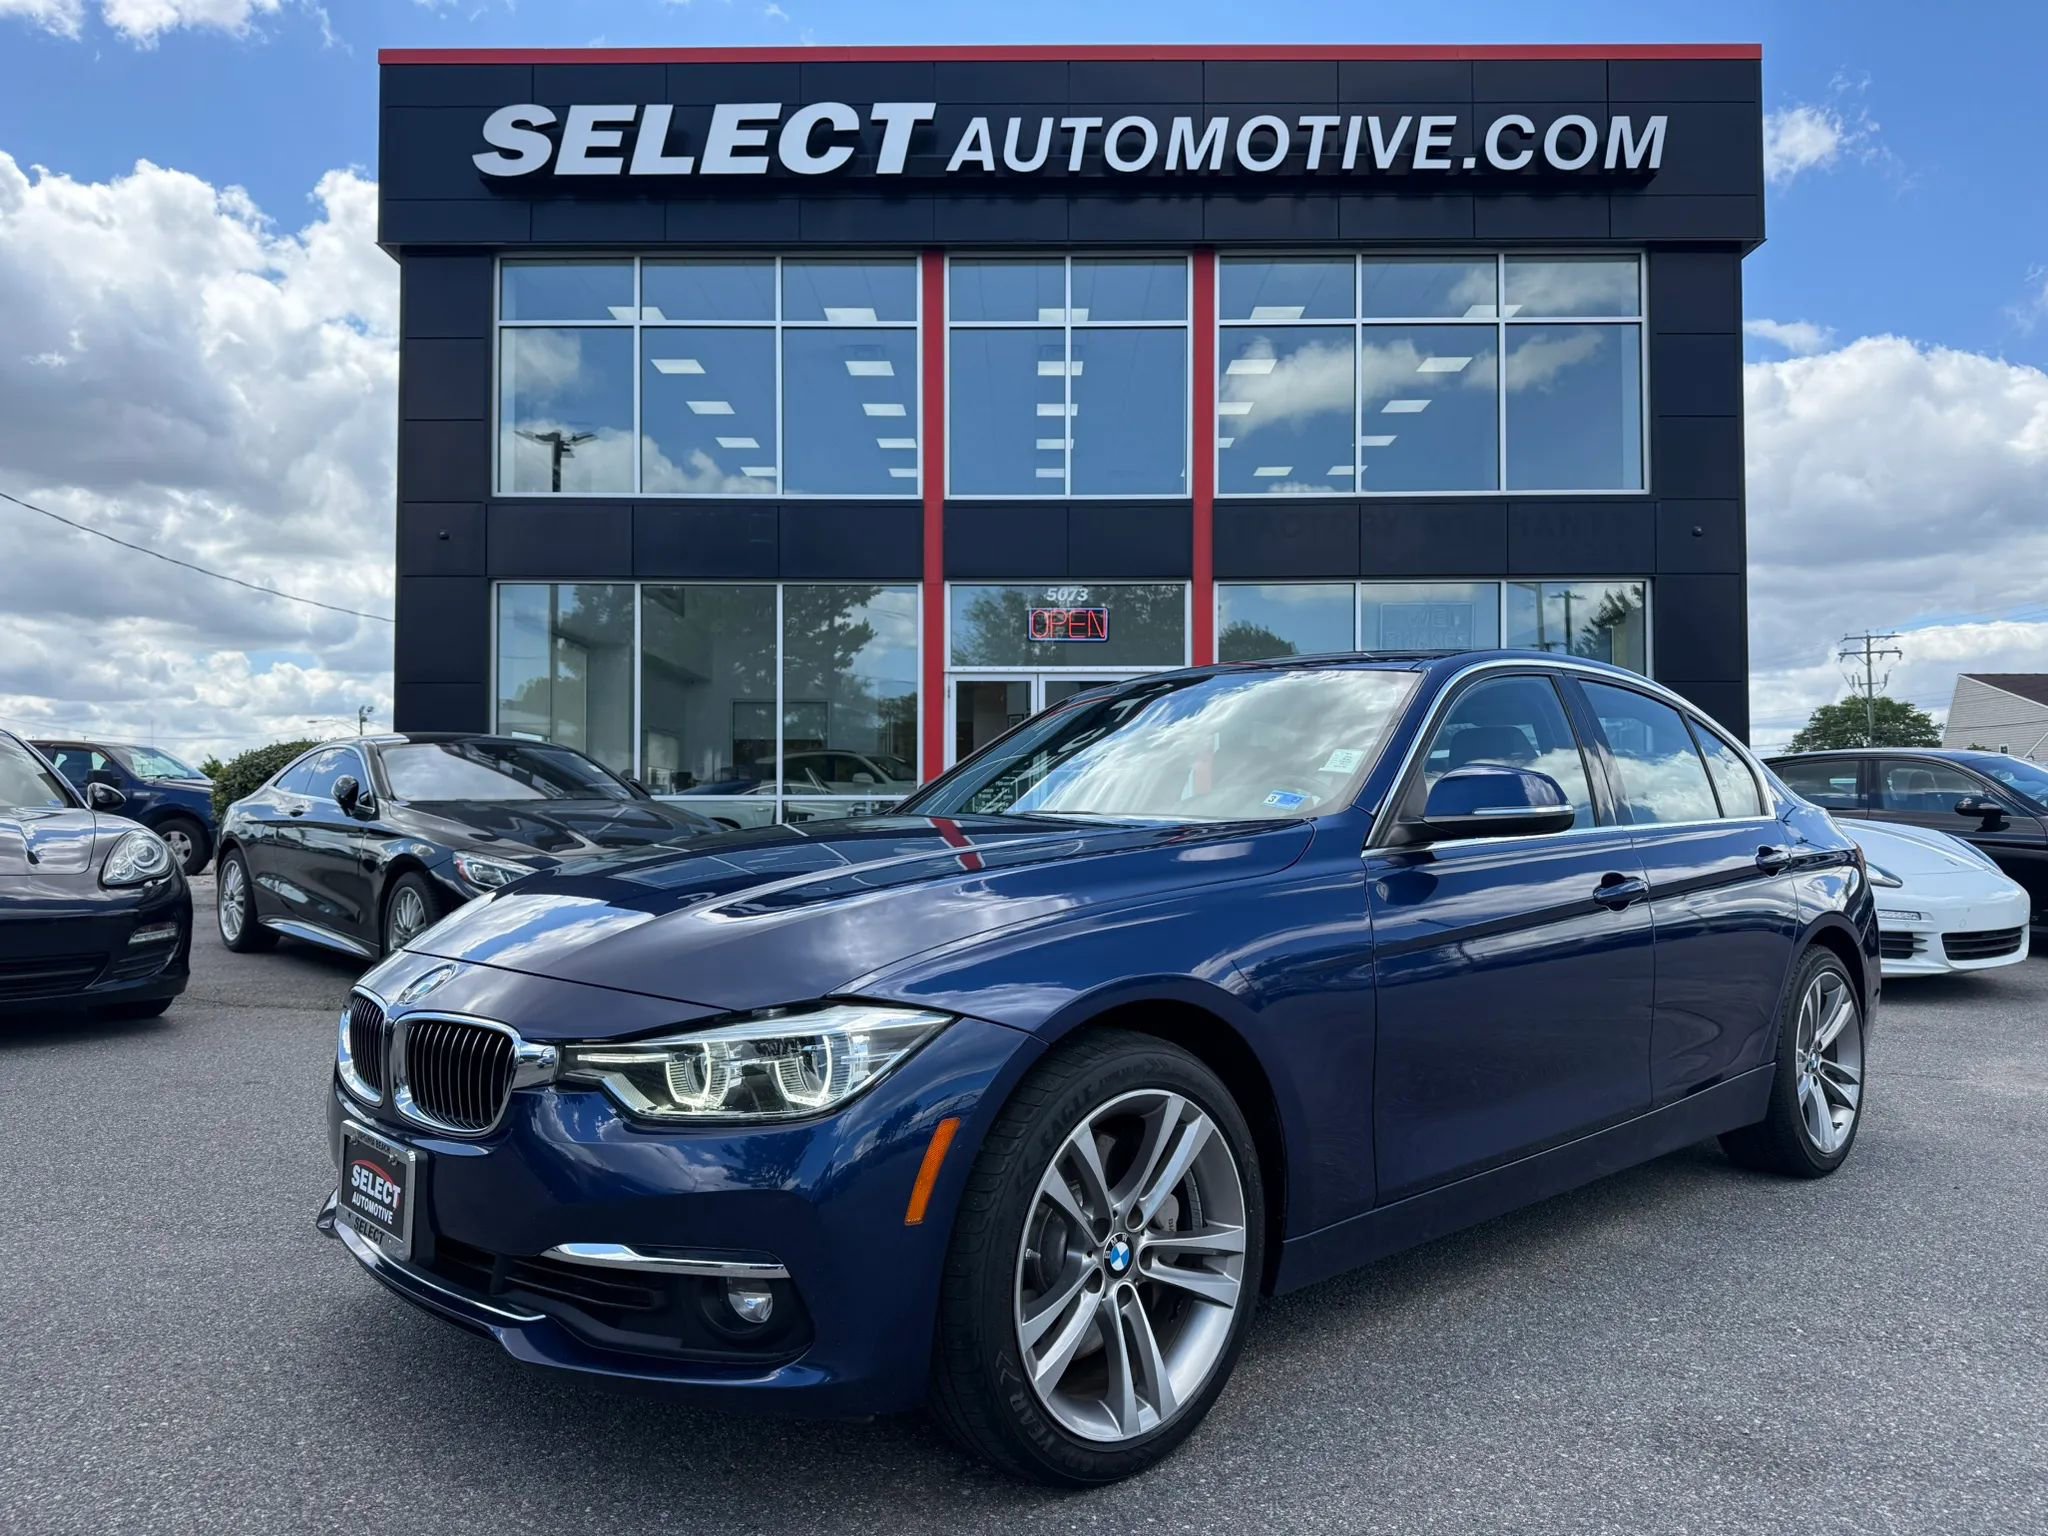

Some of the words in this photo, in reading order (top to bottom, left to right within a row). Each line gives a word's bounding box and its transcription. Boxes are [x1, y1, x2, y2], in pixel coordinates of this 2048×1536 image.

[472, 101, 936, 176] SELECT
[946, 113, 1669, 172] AUTOMOTIVE.COM
[1046, 587, 1088, 601] 5073
[1031, 609, 1107, 638] OPEN
[351, 1164, 401, 1209] SELECT
[352, 1191, 393, 1225] AUTOMOTIVE
[354, 1217, 385, 1246] SELECT
